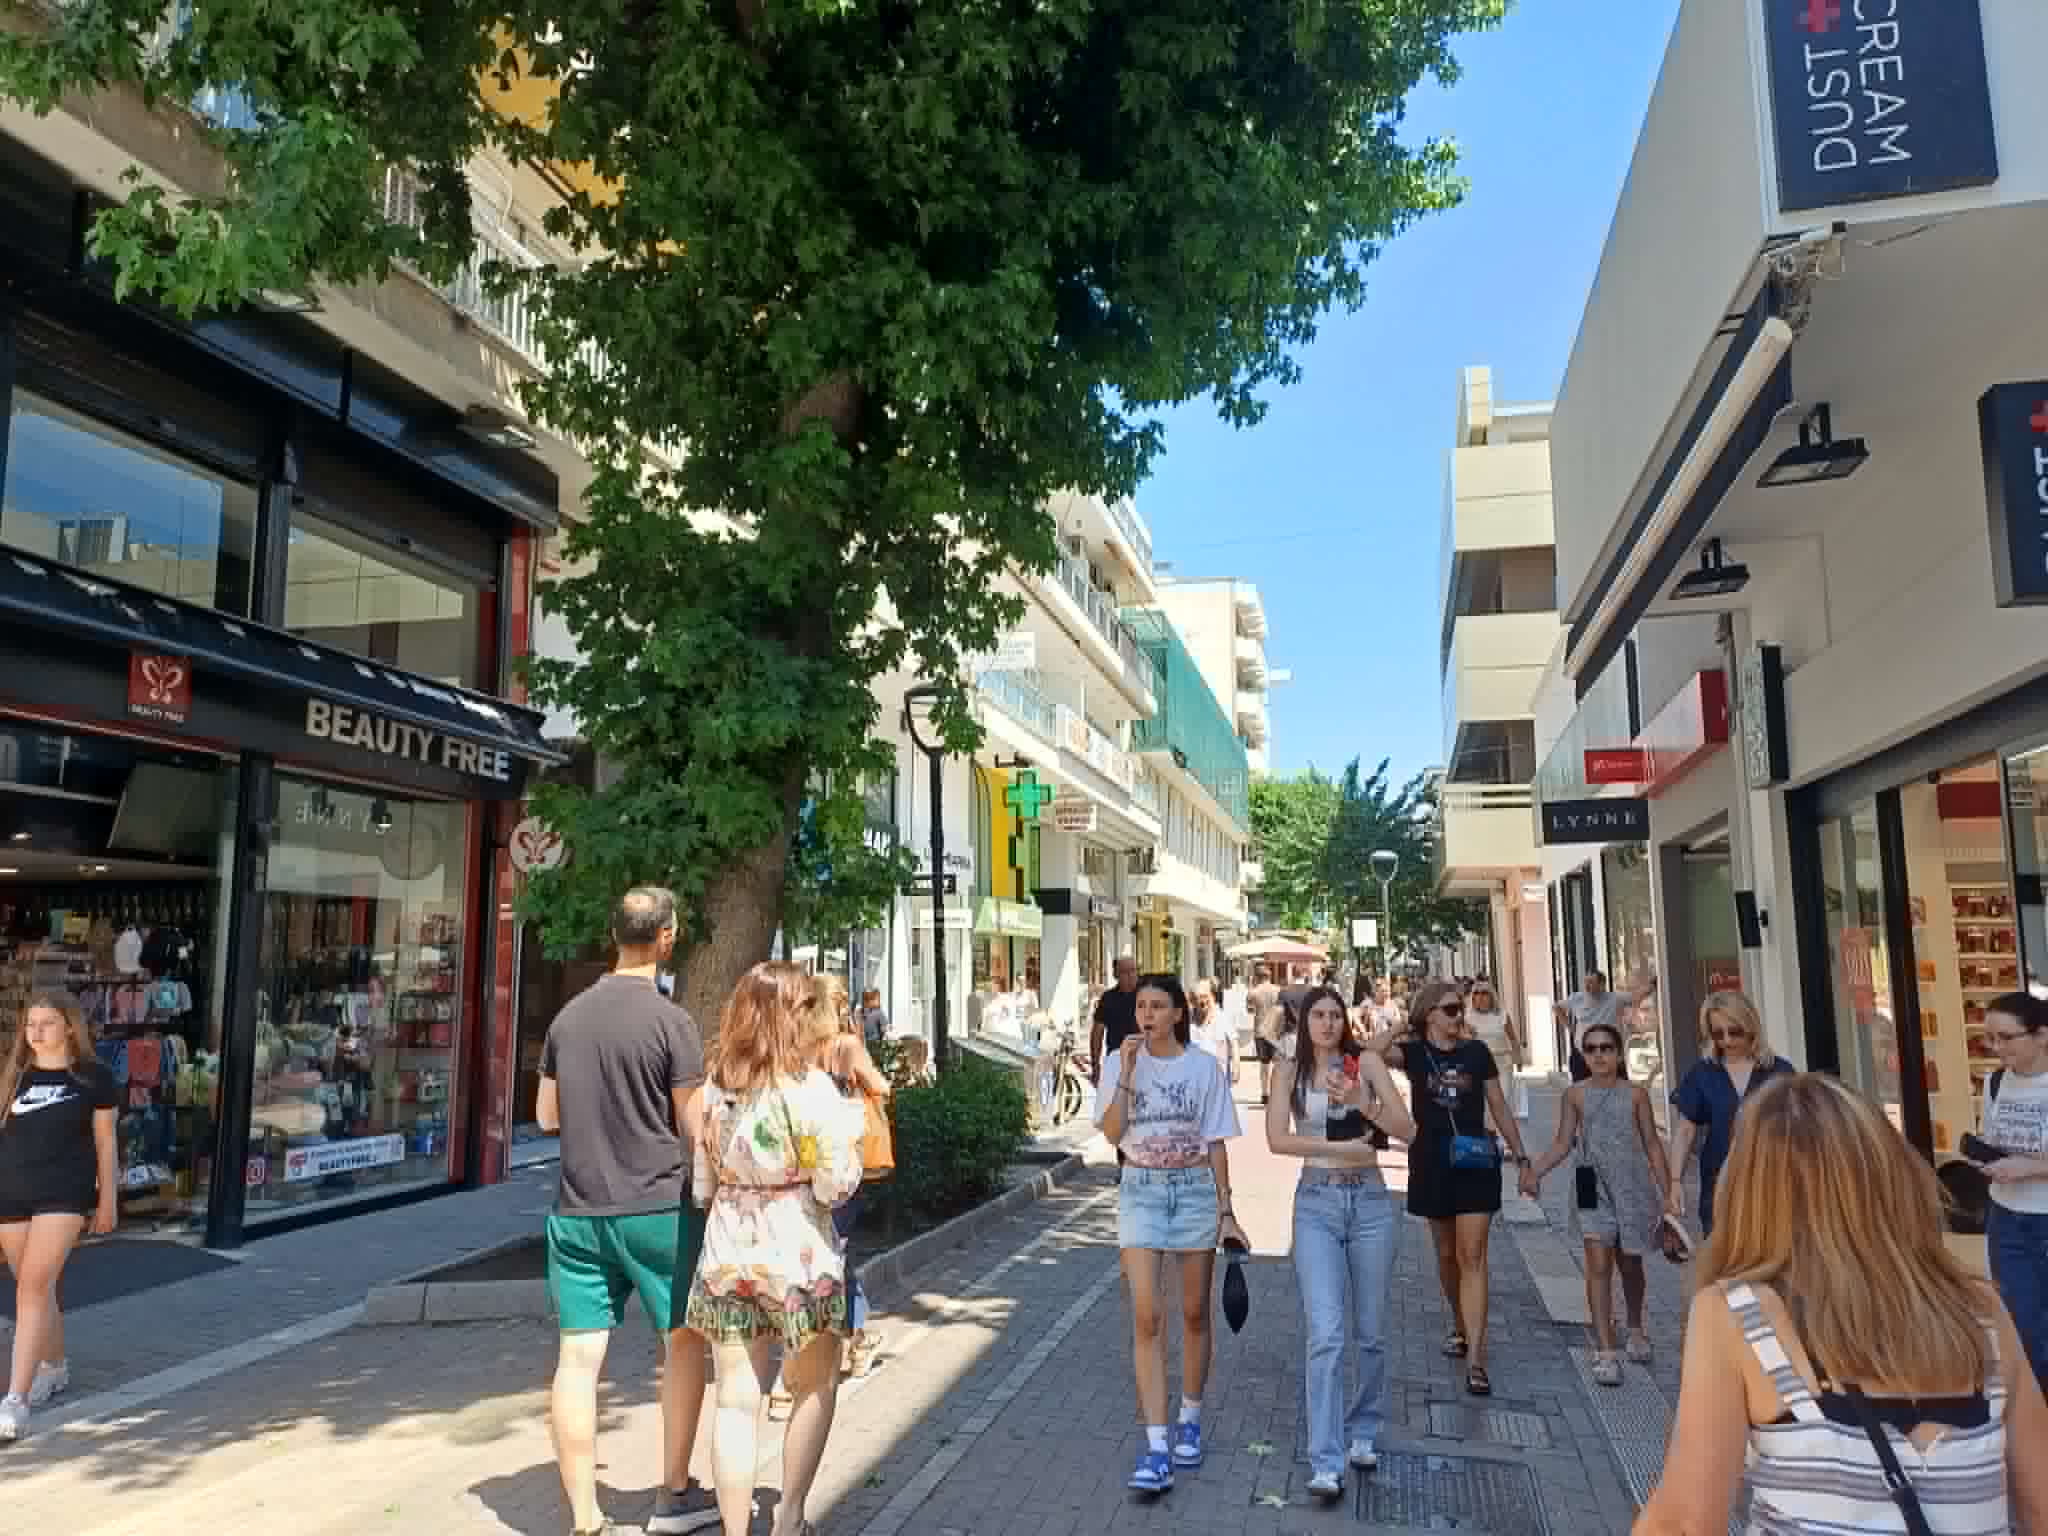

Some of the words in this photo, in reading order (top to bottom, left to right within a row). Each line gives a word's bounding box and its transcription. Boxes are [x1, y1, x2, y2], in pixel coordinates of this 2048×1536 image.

[1803, 41, 1858, 171] DUST
[304, 699, 433, 762] BEAUTY
[441, 735, 510, 783] FREE
[1552, 810, 1638, 830] LYNNE
